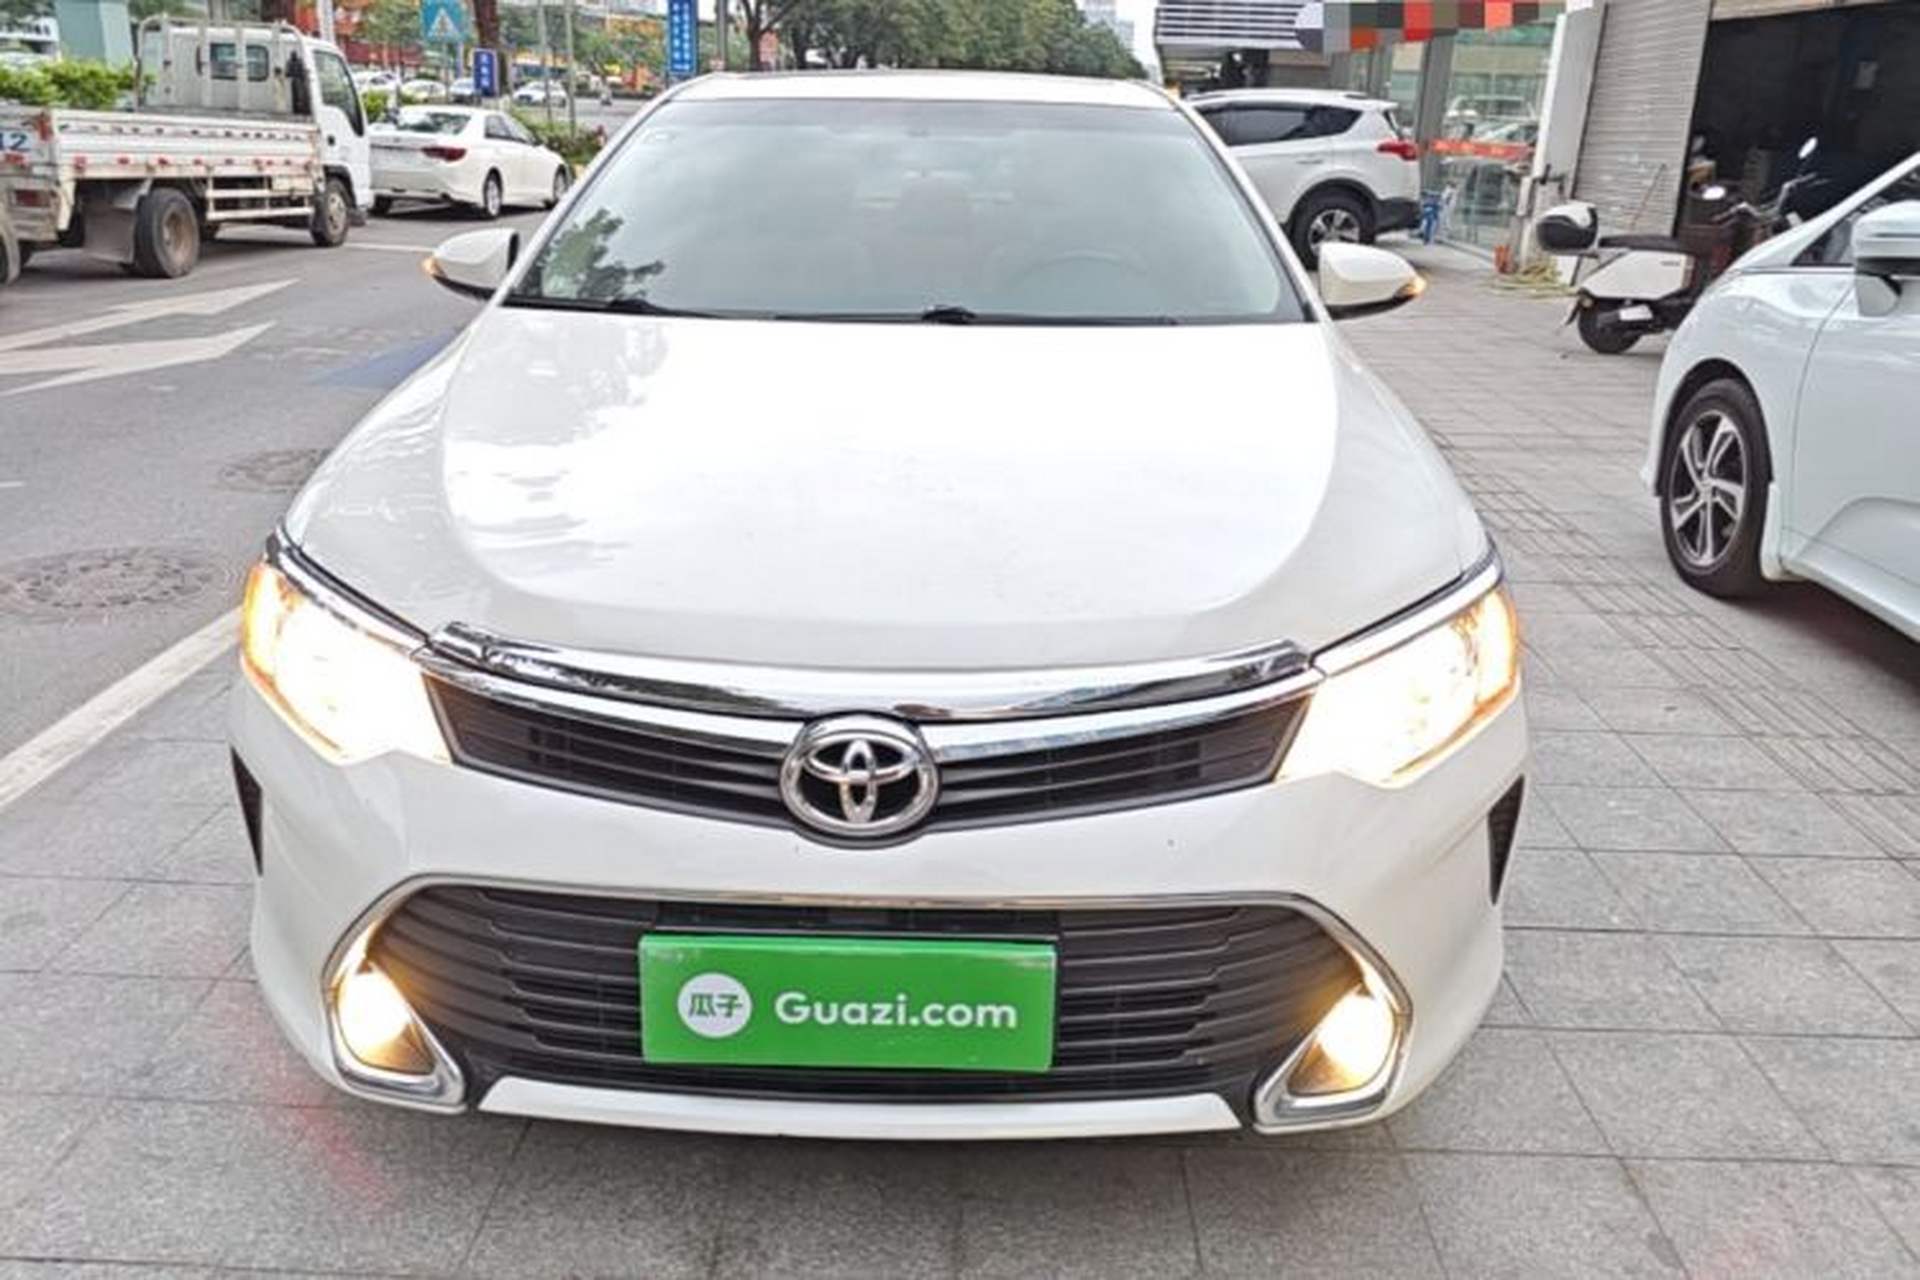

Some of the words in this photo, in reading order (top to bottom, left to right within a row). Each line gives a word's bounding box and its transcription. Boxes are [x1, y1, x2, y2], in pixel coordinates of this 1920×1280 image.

[0, 131, 31, 152] 2
[688, 993, 743, 1018] 瓜子
[775, 991, 1017, 1029] Guazi.com
